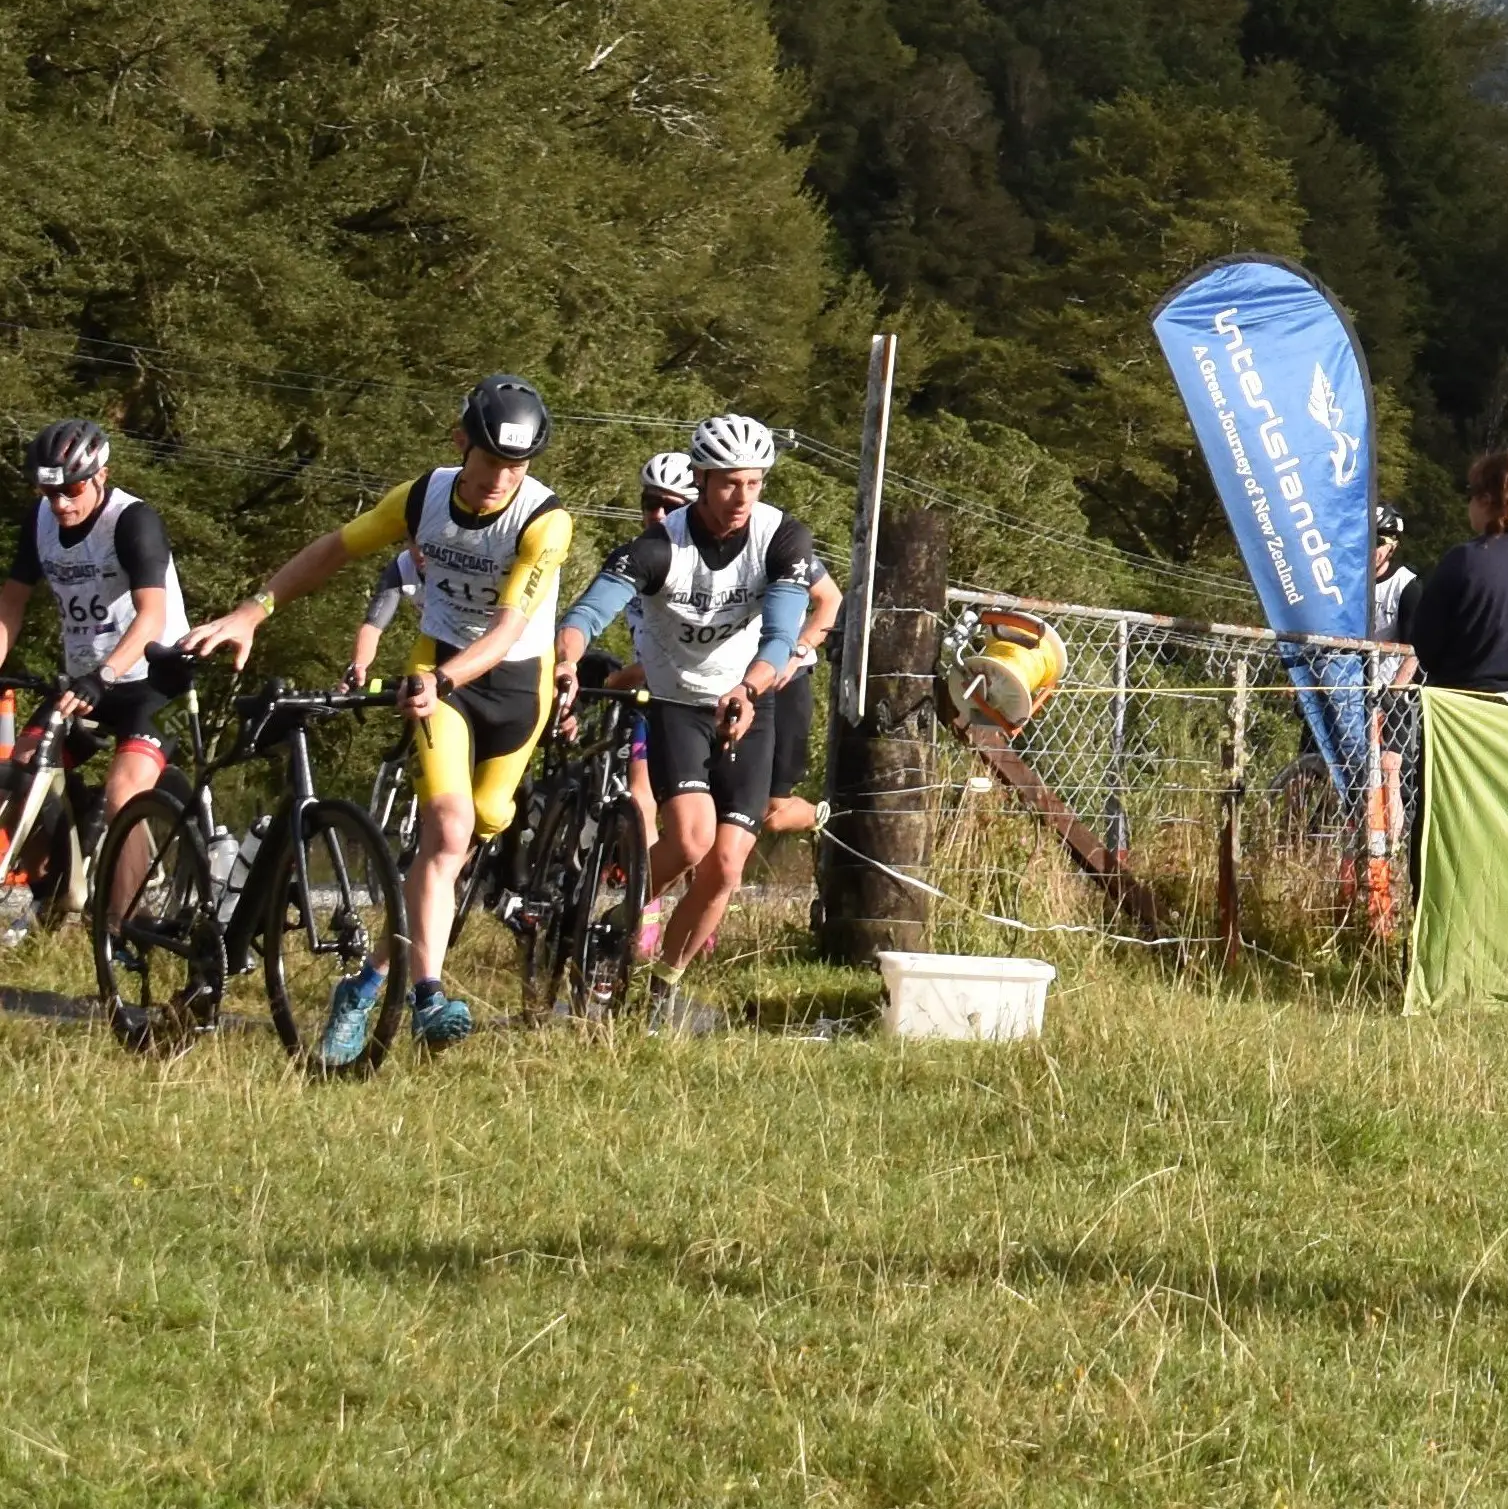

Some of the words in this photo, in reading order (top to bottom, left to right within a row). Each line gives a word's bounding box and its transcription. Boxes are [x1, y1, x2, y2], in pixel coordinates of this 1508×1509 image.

[1192, 346, 1209, 361] A
[1200, 359, 1227, 408] Great
[1218, 410, 1253, 475] Journey
[1244, 478, 1264, 497] of
[1252, 496, 1275, 537] New
[423, 543, 452, 564] COAST
[463, 554, 494, 573] COAST
[1267, 536, 1304, 606] Zealand
[673, 591, 708, 608] COAST
[714, 588, 748, 606] COAST
